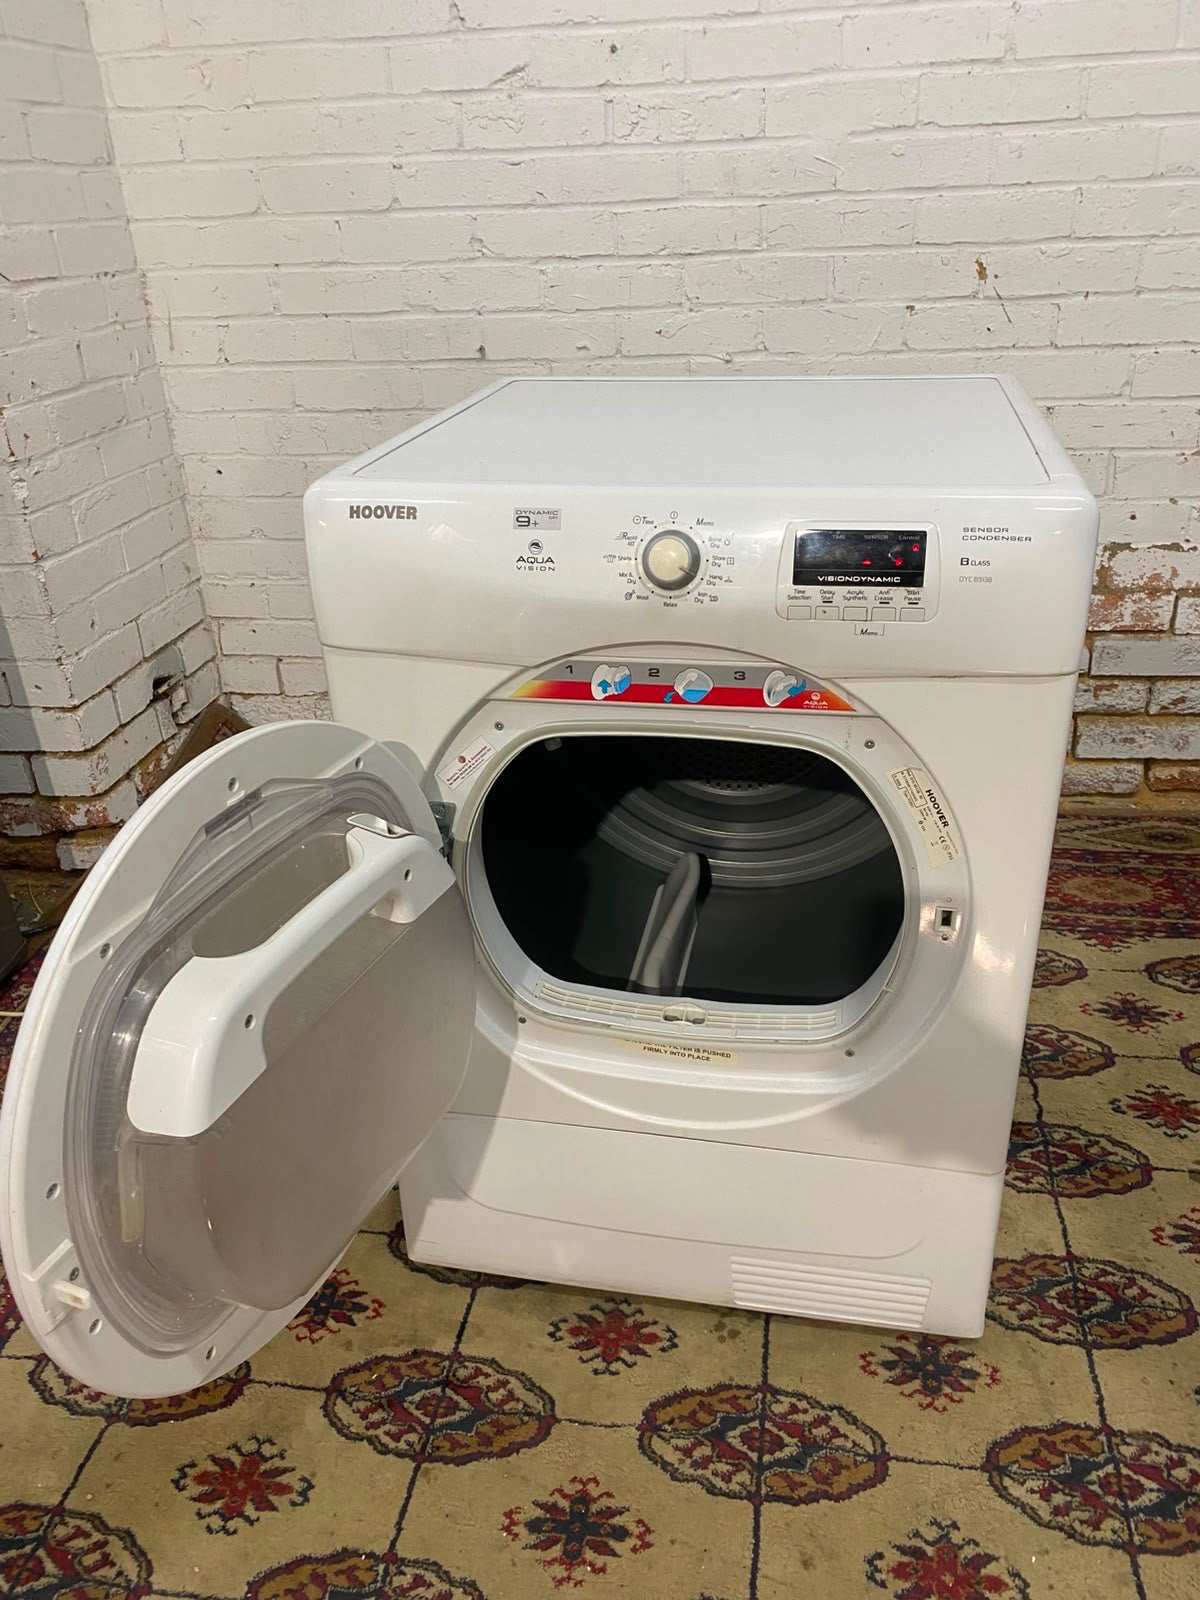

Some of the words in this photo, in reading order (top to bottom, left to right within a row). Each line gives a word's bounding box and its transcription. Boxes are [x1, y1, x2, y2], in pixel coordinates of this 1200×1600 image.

[349, 505, 417, 519] HOOVER
[642, 516, 655, 525] Time
[516, 556, 555, 564] AQUA
[960, 557, 970, 566] B
[817, 575, 901, 583] VISIONDYNAMIC
[860, 628, 879, 636] Memo
[565, 665, 574, 673] 1
[648, 668, 660, 677] 2
[734, 671, 746, 681] 3
[925, 789, 950, 828] HOOVER
[643, 1045, 668, 1054] FIRMLY
[669, 1050, 687, 1058] INTO
[687, 1053, 711, 1062] PLACE
[702, 1048, 732, 1059] PUSHED
